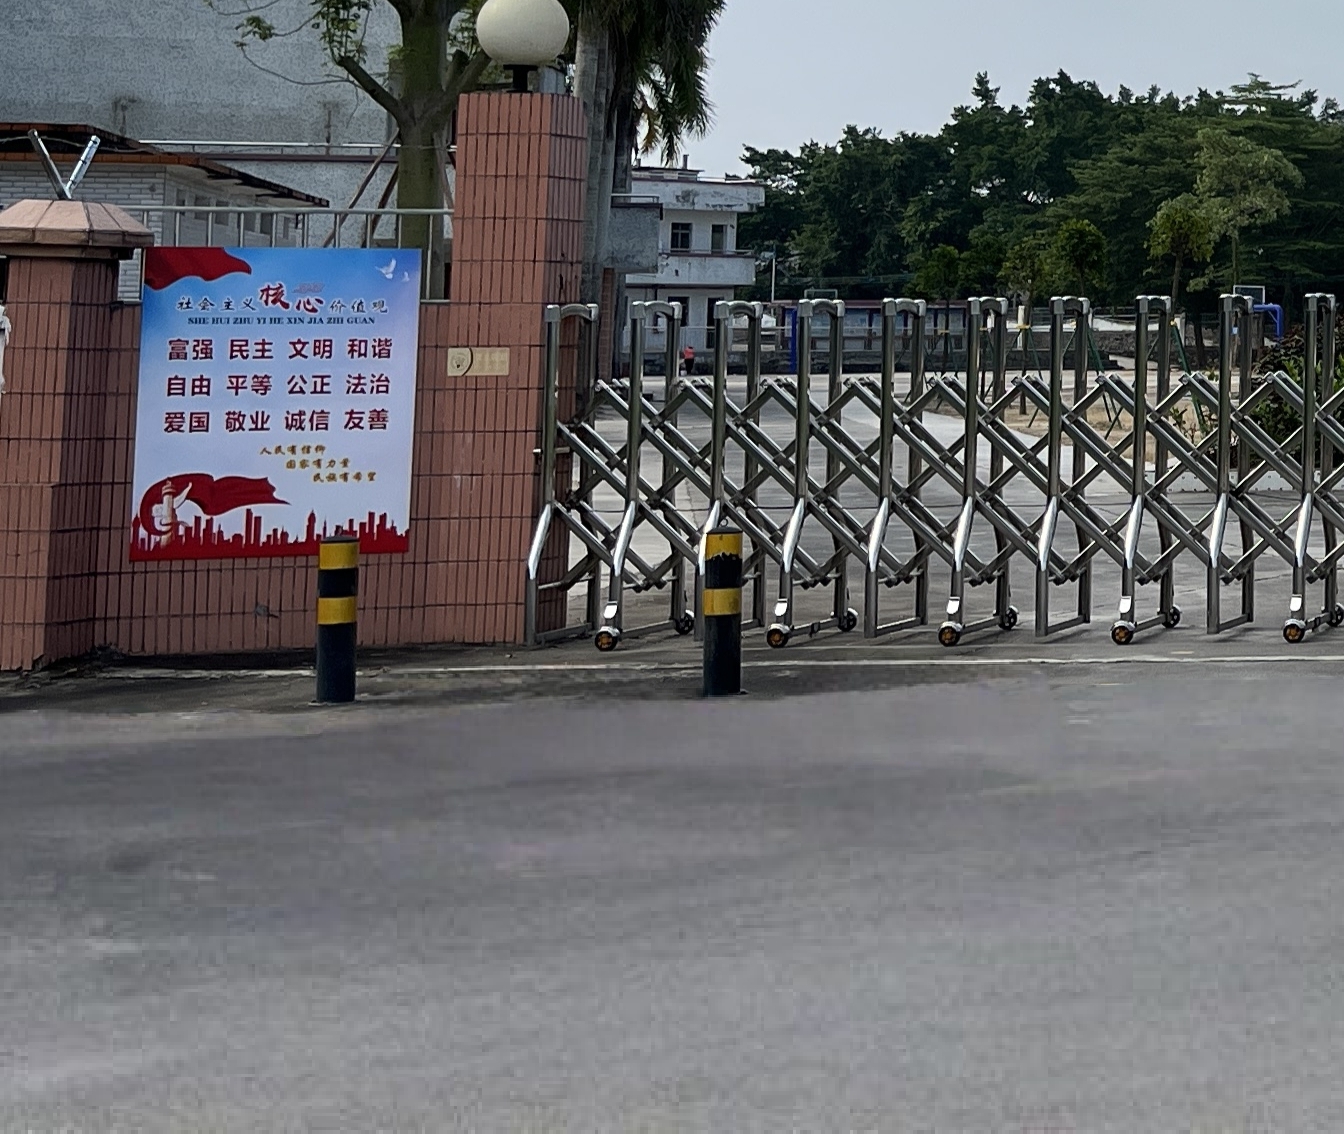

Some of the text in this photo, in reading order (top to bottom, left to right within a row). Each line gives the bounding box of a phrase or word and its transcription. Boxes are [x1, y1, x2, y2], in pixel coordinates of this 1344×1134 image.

[176, 282, 389, 314] 社会主义核心价值观
[187, 317, 375, 325] SHE HUI ZHU YI HE XIN JIA ZHI GUAN
[168, 338, 393, 361] 富强 民主 文明 和谐
[166, 373, 390, 397] 自由 平等 公正 法治
[164, 408, 389, 434] 爱国 敬业 诚信 友善
